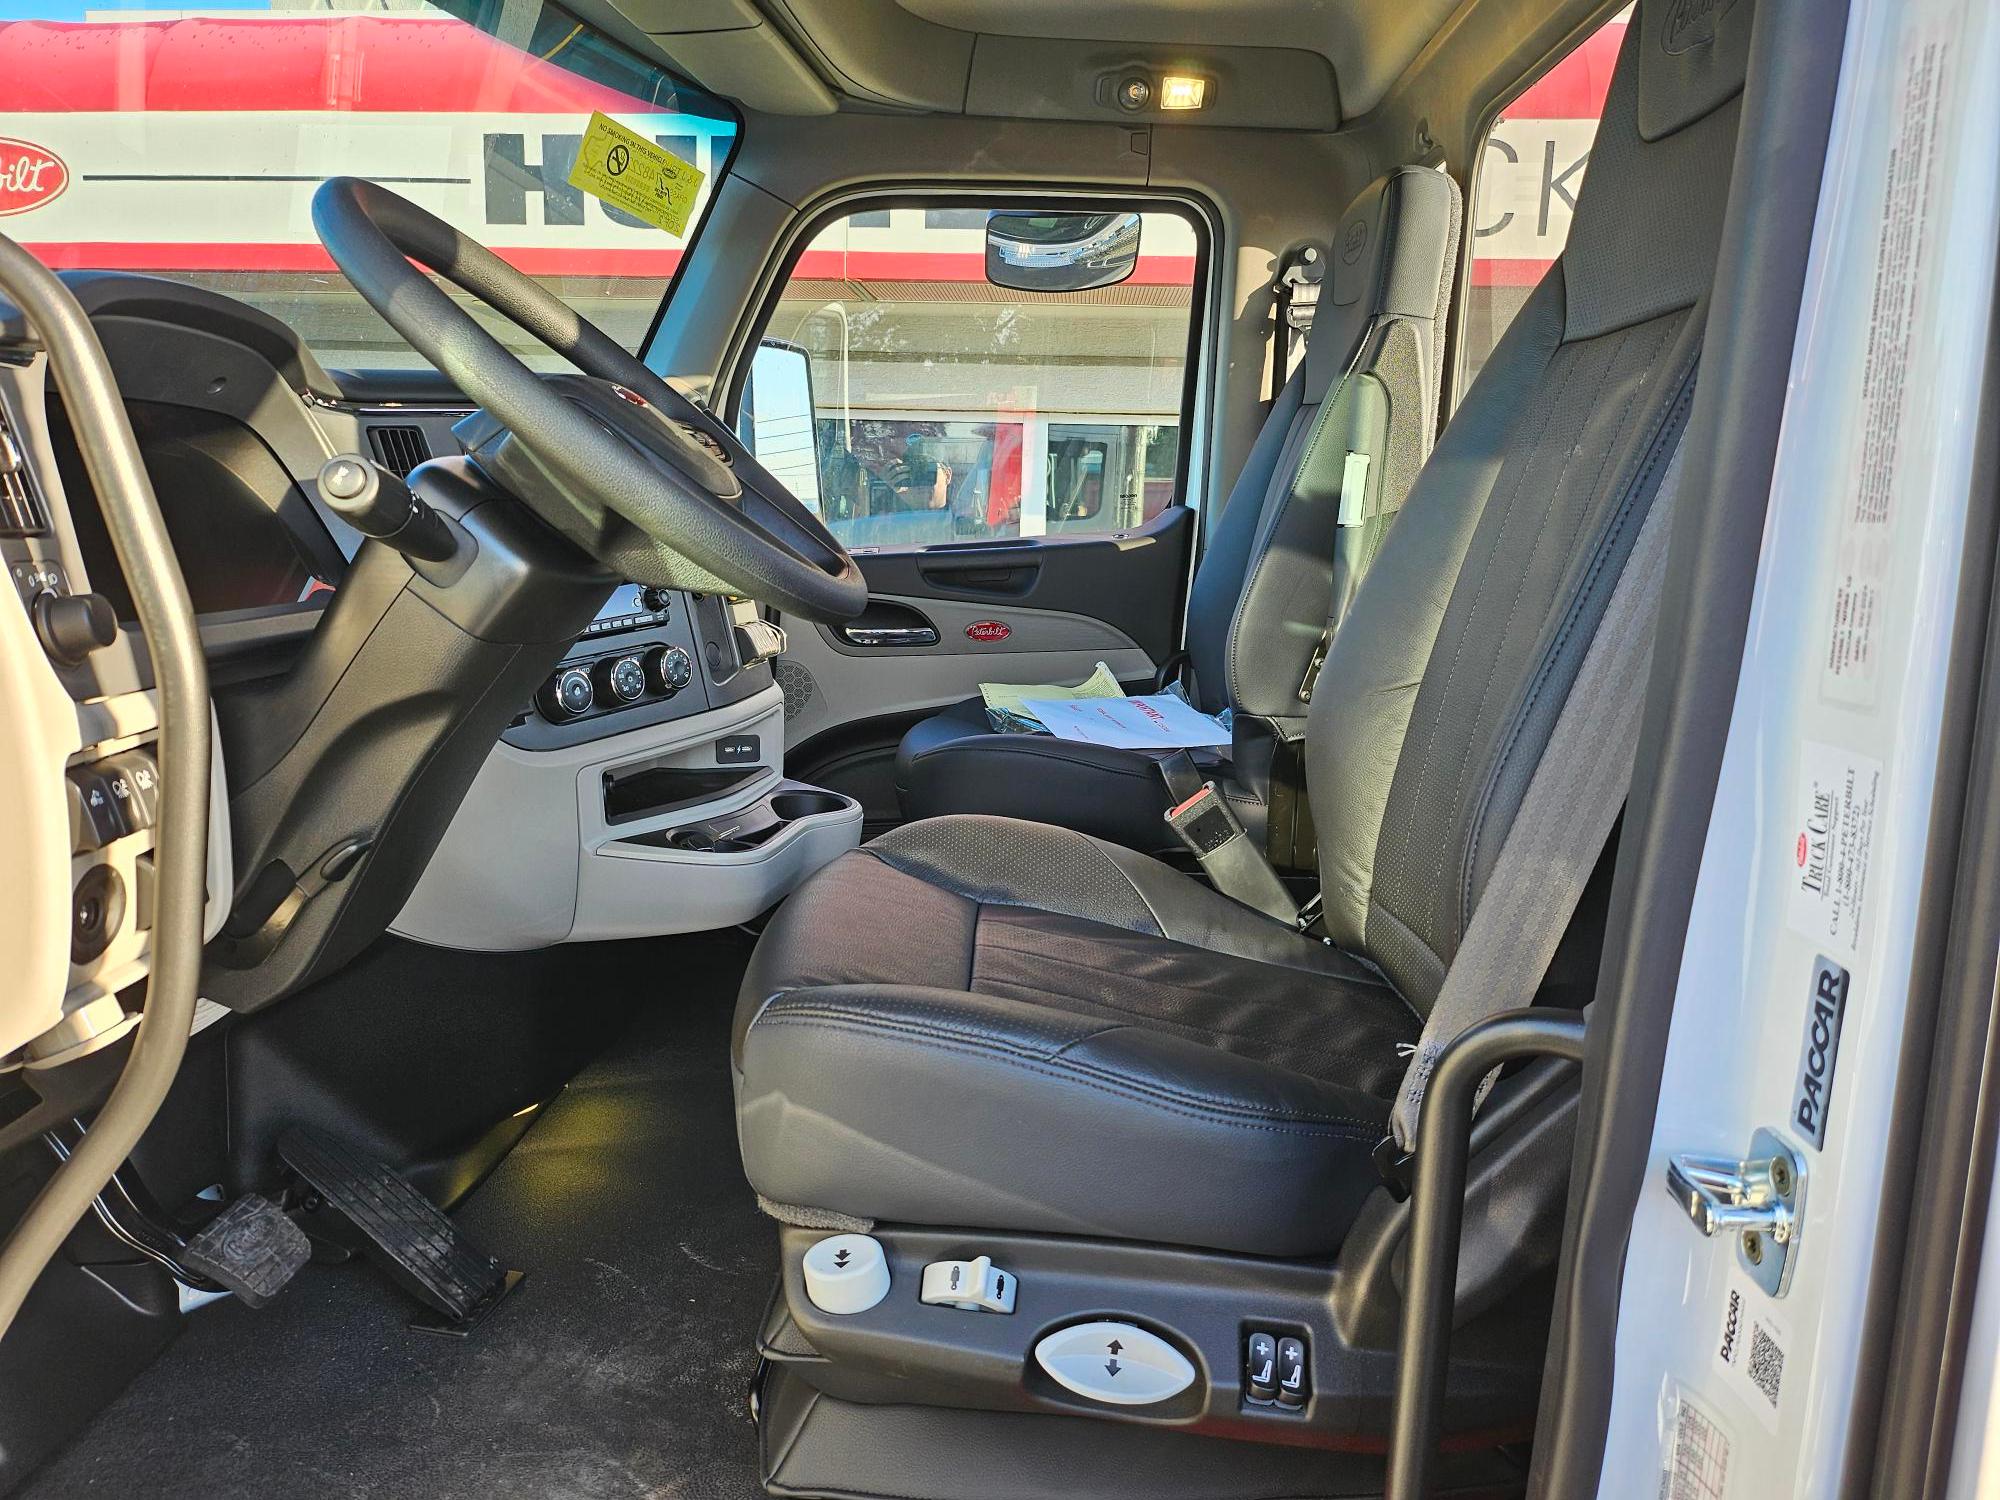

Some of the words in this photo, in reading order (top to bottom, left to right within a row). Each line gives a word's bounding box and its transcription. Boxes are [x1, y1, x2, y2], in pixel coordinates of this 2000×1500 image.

[599, 123, 608, 132] NO
[607, 128, 631, 145] SMOKING
[630, 140, 637, 148] IN
[636, 144, 648, 155] THIS
[0, 155, 56, 192] ilt
[968, 624, 1008, 637] Peterbilt
[1807, 789, 1830, 834] CARE
[1801, 841, 1826, 895] TRUCK
[1829, 898, 1841, 936] CALL
[1797, 968, 1840, 1136] PACCAR
[1720, 1289, 1740, 1363] PACCAR
